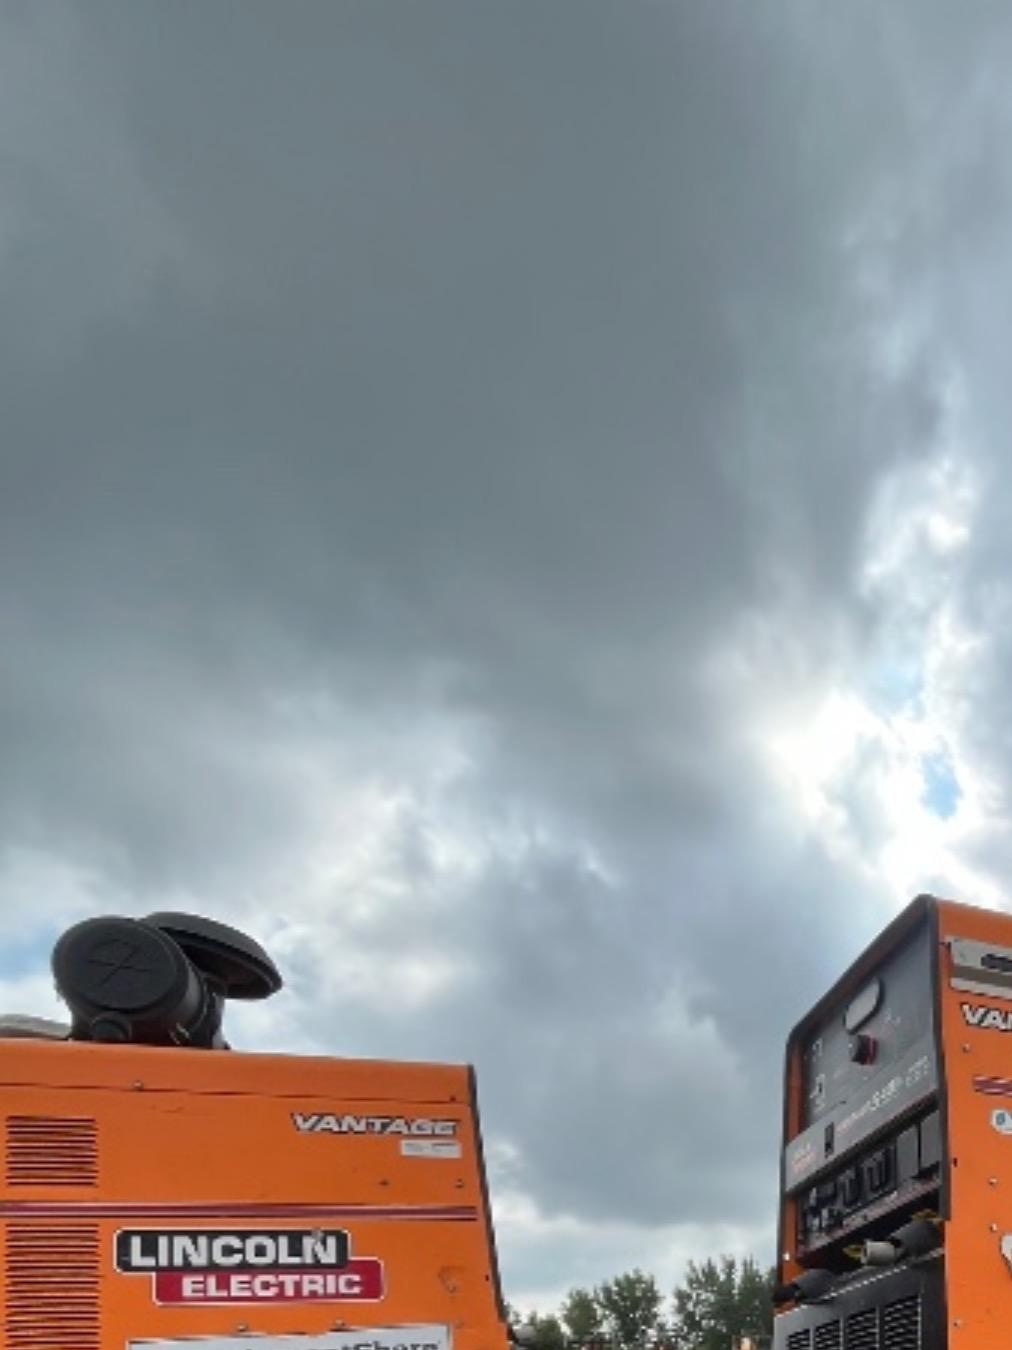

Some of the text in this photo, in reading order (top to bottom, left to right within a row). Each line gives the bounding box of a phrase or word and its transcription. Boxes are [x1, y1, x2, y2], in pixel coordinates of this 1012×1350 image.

[293, 1113, 458, 1136] VANTAGE
[129, 1233, 338, 1267] LINCOLN
[181, 1273, 363, 1298] ELECTRIC
